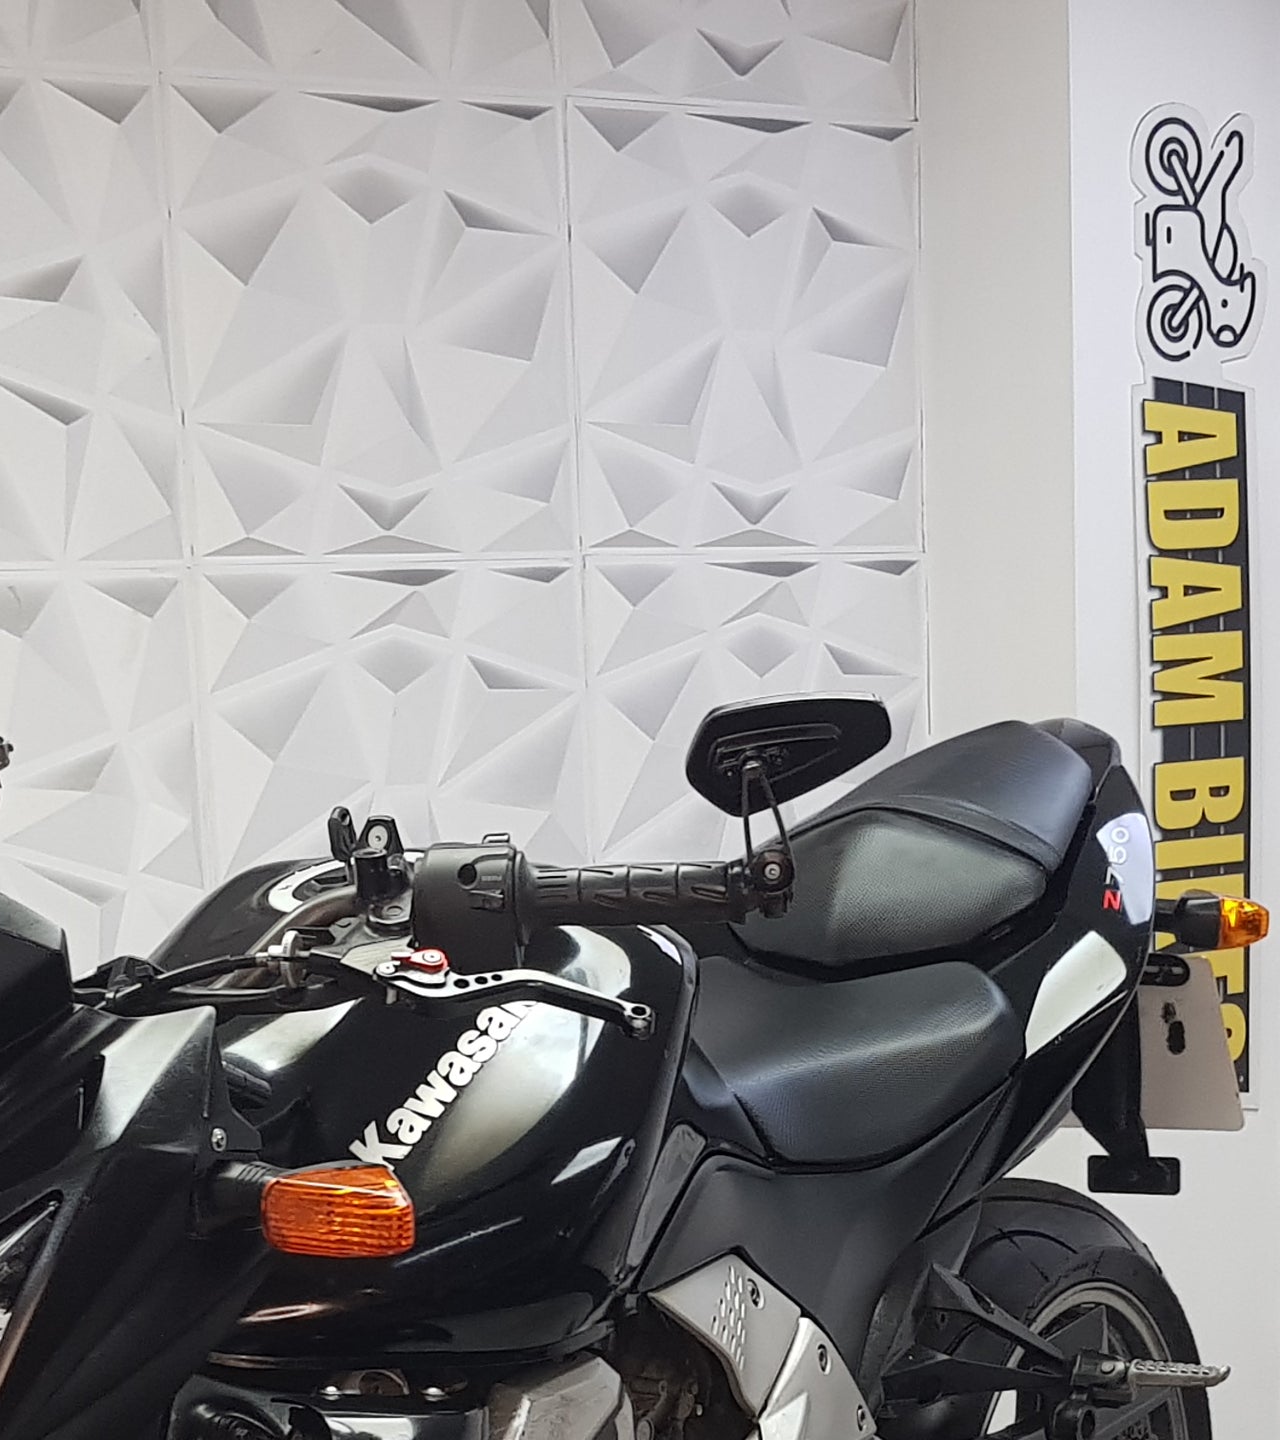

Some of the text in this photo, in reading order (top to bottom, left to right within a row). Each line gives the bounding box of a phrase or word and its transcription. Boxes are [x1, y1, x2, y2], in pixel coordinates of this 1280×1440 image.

[1143, 399, 1245, 727] ADAM
[1102, 826, 1129, 911] Z750
[349, 1000, 538, 1171] Kawasa
